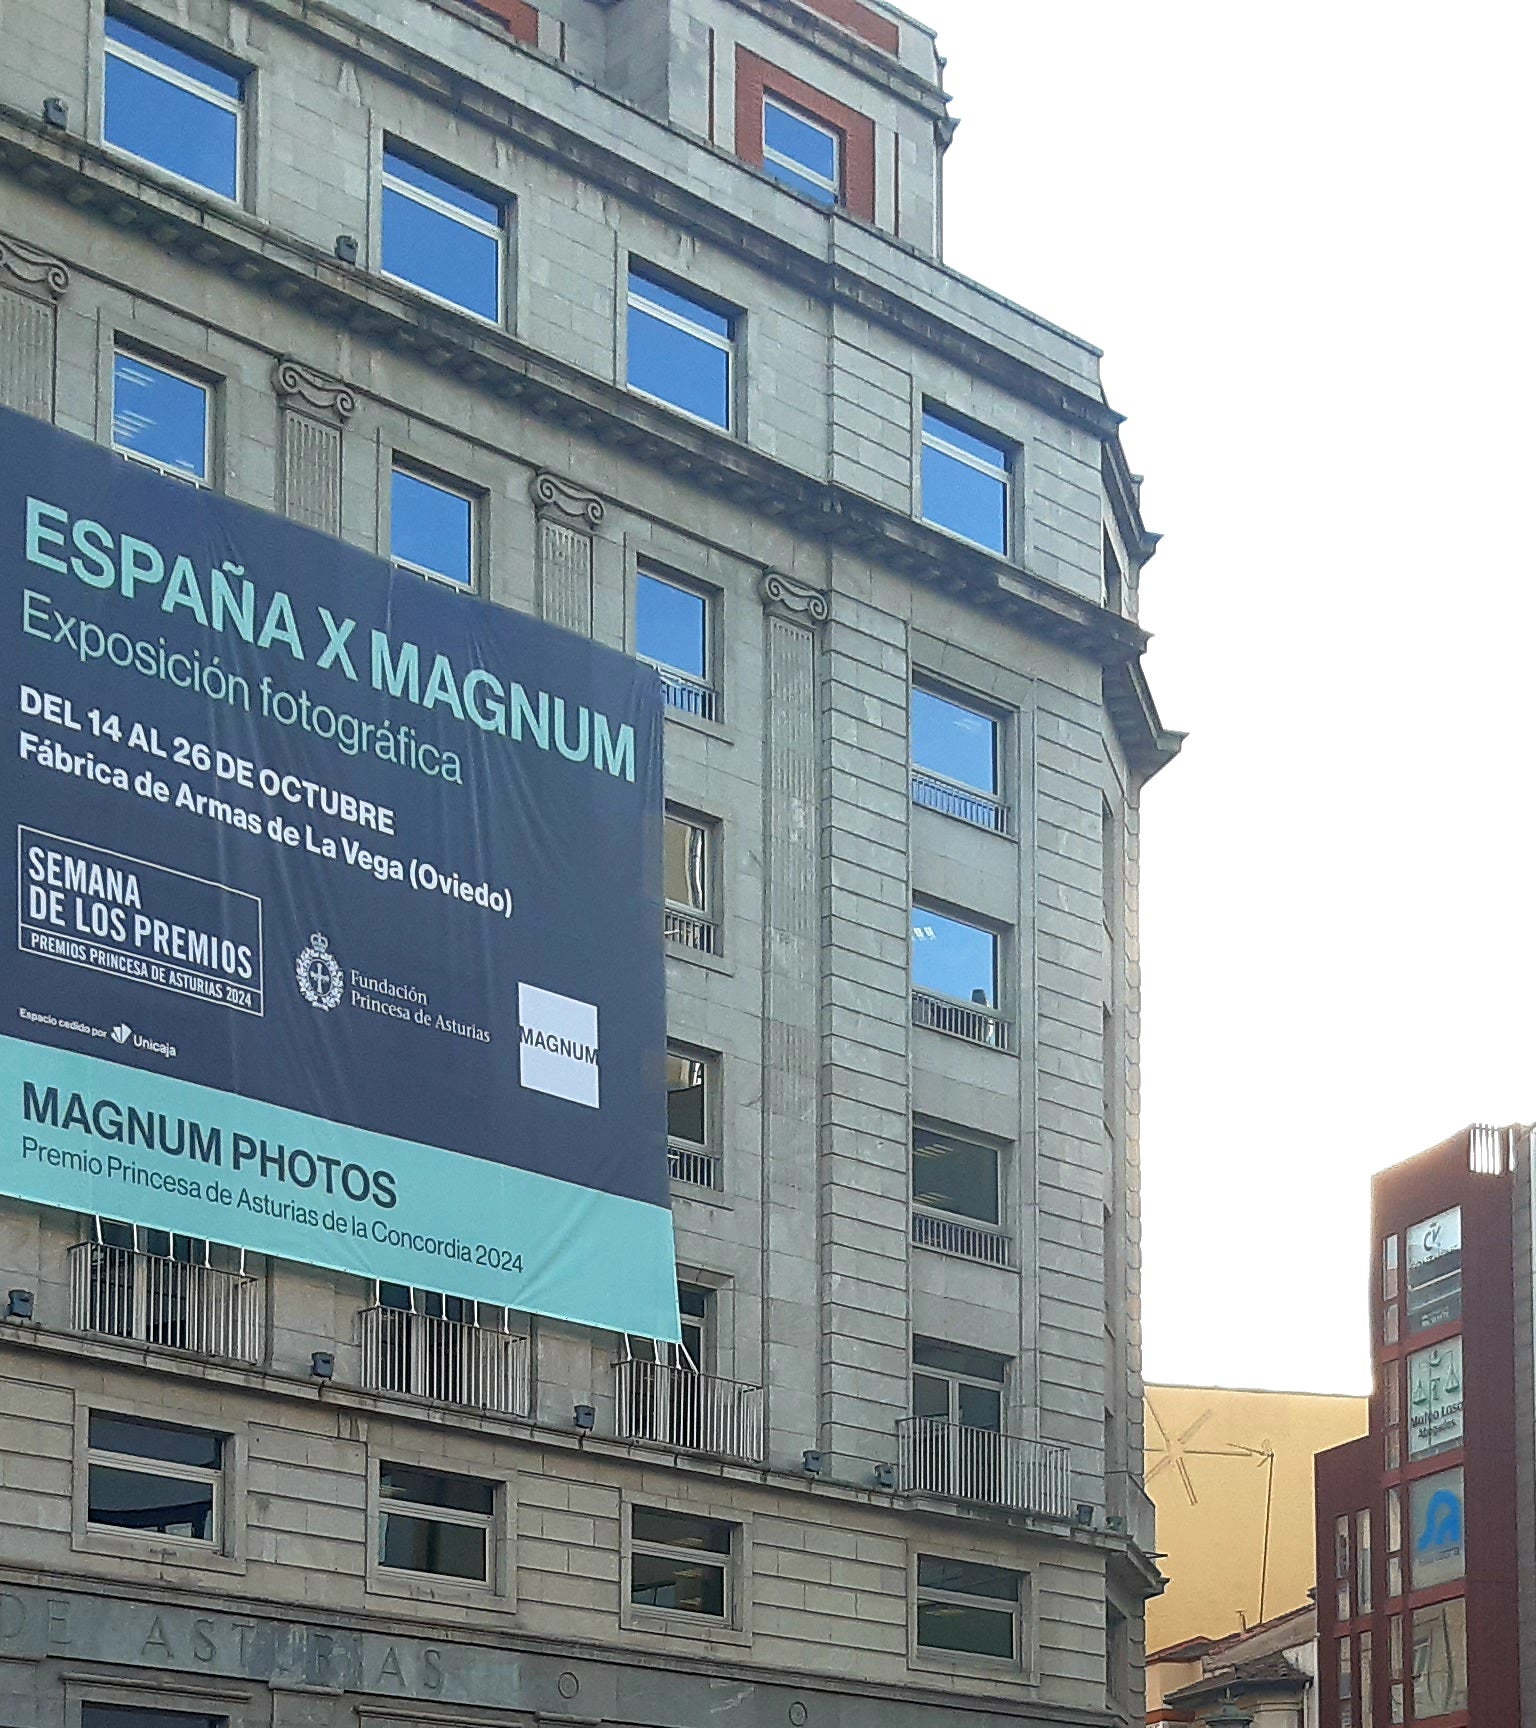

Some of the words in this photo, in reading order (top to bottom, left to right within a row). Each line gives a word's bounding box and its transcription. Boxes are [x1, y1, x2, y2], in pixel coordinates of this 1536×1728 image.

[26, 495, 305, 661] ESPAÑA
[317, 606, 358, 681] X
[370, 629, 635, 783] MAGNUM
[22, 588, 250, 712] Exposición
[260, 676, 463, 784] fotográfica
[19, 684, 82, 731] DEL
[87, 708, 122, 742] 14
[127, 722, 167, 759] AL
[172, 736, 211, 771] 26
[216, 750, 254, 789] DE
[259, 768, 395, 836] OCTUBRE
[19, 729, 129, 792] Fábrica
[134, 770, 170, 802] de
[175, 783, 263, 835] Armas
[267, 815, 301, 847] de
[305, 824, 337, 860] La
[341, 836, 404, 881] Vega
[409, 858, 513, 919] (Oviedo)
[27, 846, 142, 910] SEMANA
[29, 884, 66, 927] DE
[75, 896, 127, 943] LOS
[133, 913, 253, 980] PREMIOS
[30, 932, 87, 961] PREMIOS
[89, 948, 149, 978] PRINCESA
[151, 965, 167, 984] DE
[168, 971, 223, 999] ASTURIAS
[226, 987, 252, 1008] 2024
[19, 1007, 57, 1027] Espacio
[58, 1015, 90, 1034] cedido
[91, 1024, 108, 1040] por
[350, 968, 428, 1007] Fundación
[350, 990, 411, 1022] Princesa
[414, 1008, 432, 1027] de
[434, 1013, 491, 1044] Asturias
[133, 1034, 177, 1058] Unicaja
[519, 1025, 599, 1067] MAGNUM
[23, 1080, 222, 1167] MAGNUM
[232, 1132, 397, 1209] PHOTOS
[22, 1135, 103, 1175] Premio
[107, 1155, 201, 1199] Princesa
[206, 1181, 232, 1206] de
[236, 1188, 319, 1227] Asturias
[322, 1210, 347, 1234] de
[352, 1215, 368, 1239] la
[372, 1220, 473, 1264] Concordia
[475, 1245, 524, 1274] 2024
[141, 1614, 446, 1690] ASTURIAS
